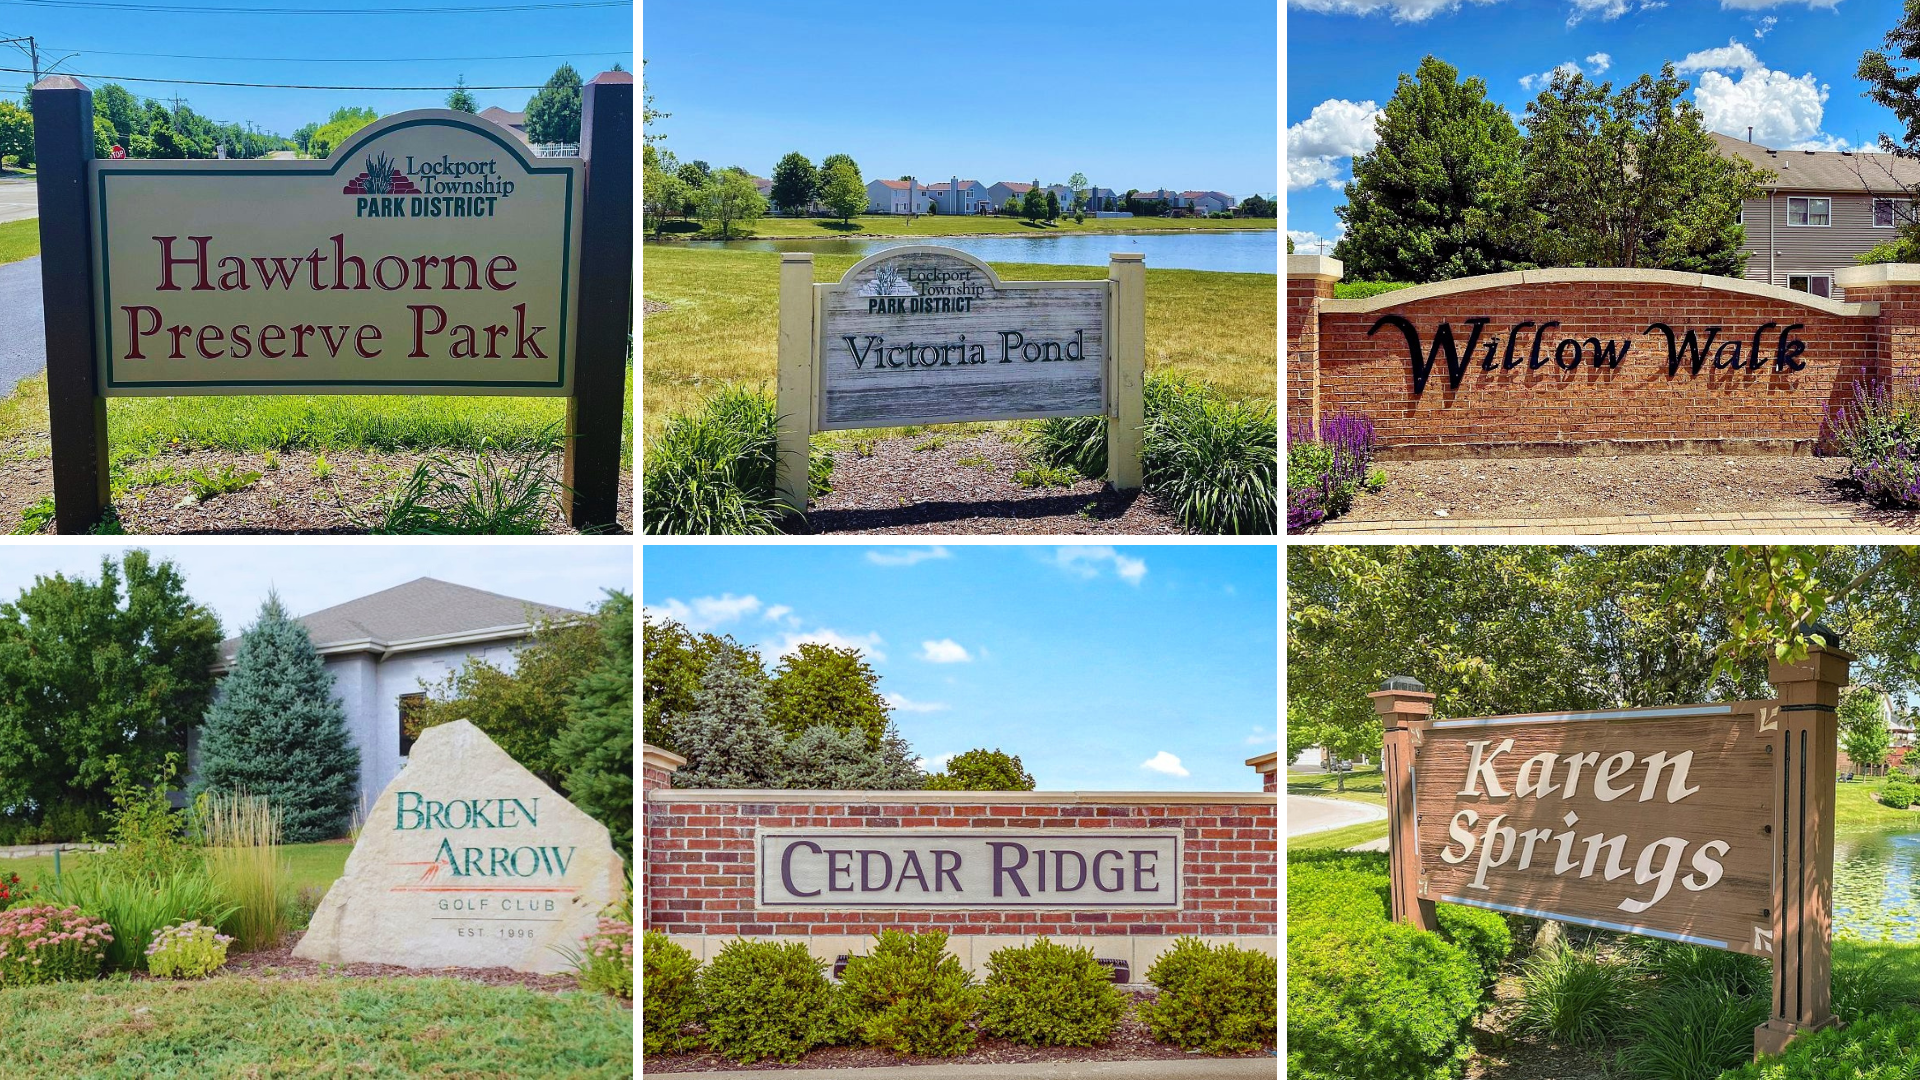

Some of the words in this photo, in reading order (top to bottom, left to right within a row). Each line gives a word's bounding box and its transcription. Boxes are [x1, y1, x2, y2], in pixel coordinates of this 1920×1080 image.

[405, 155, 497, 180] Lockport
[421, 175, 515, 199] Township
[356, 196, 405, 218] PARK
[411, 196, 498, 218] DISTRICT
[151, 233, 518, 292] Hawthorne
[907, 267, 971, 285] Lockport
[868, 297, 906, 315] PARK
[910, 296, 972, 314] DISTRICT
[917, 281, 985, 298] Township
[120, 304, 383, 360] Preserve
[406, 302, 549, 360] Park
[842, 334, 987, 371] Victoria
[998, 328, 1086, 364] Pond
[1367, 314, 1631, 395] Willow
[1643, 322, 1806, 376] Walk
[1456, 738, 1700, 804] Karen
[393, 791, 540, 831] BROKEN
[434, 837, 577, 877] ARROW
[780, 840, 963, 897] CEDAR
[986, 841, 1160, 897] RIDGE
[1440, 808, 1732, 914] Springs
[438, 899, 489, 911] GOLF
[501, 899, 555, 912] CLUB
[500, 929, 534, 938] 1996
